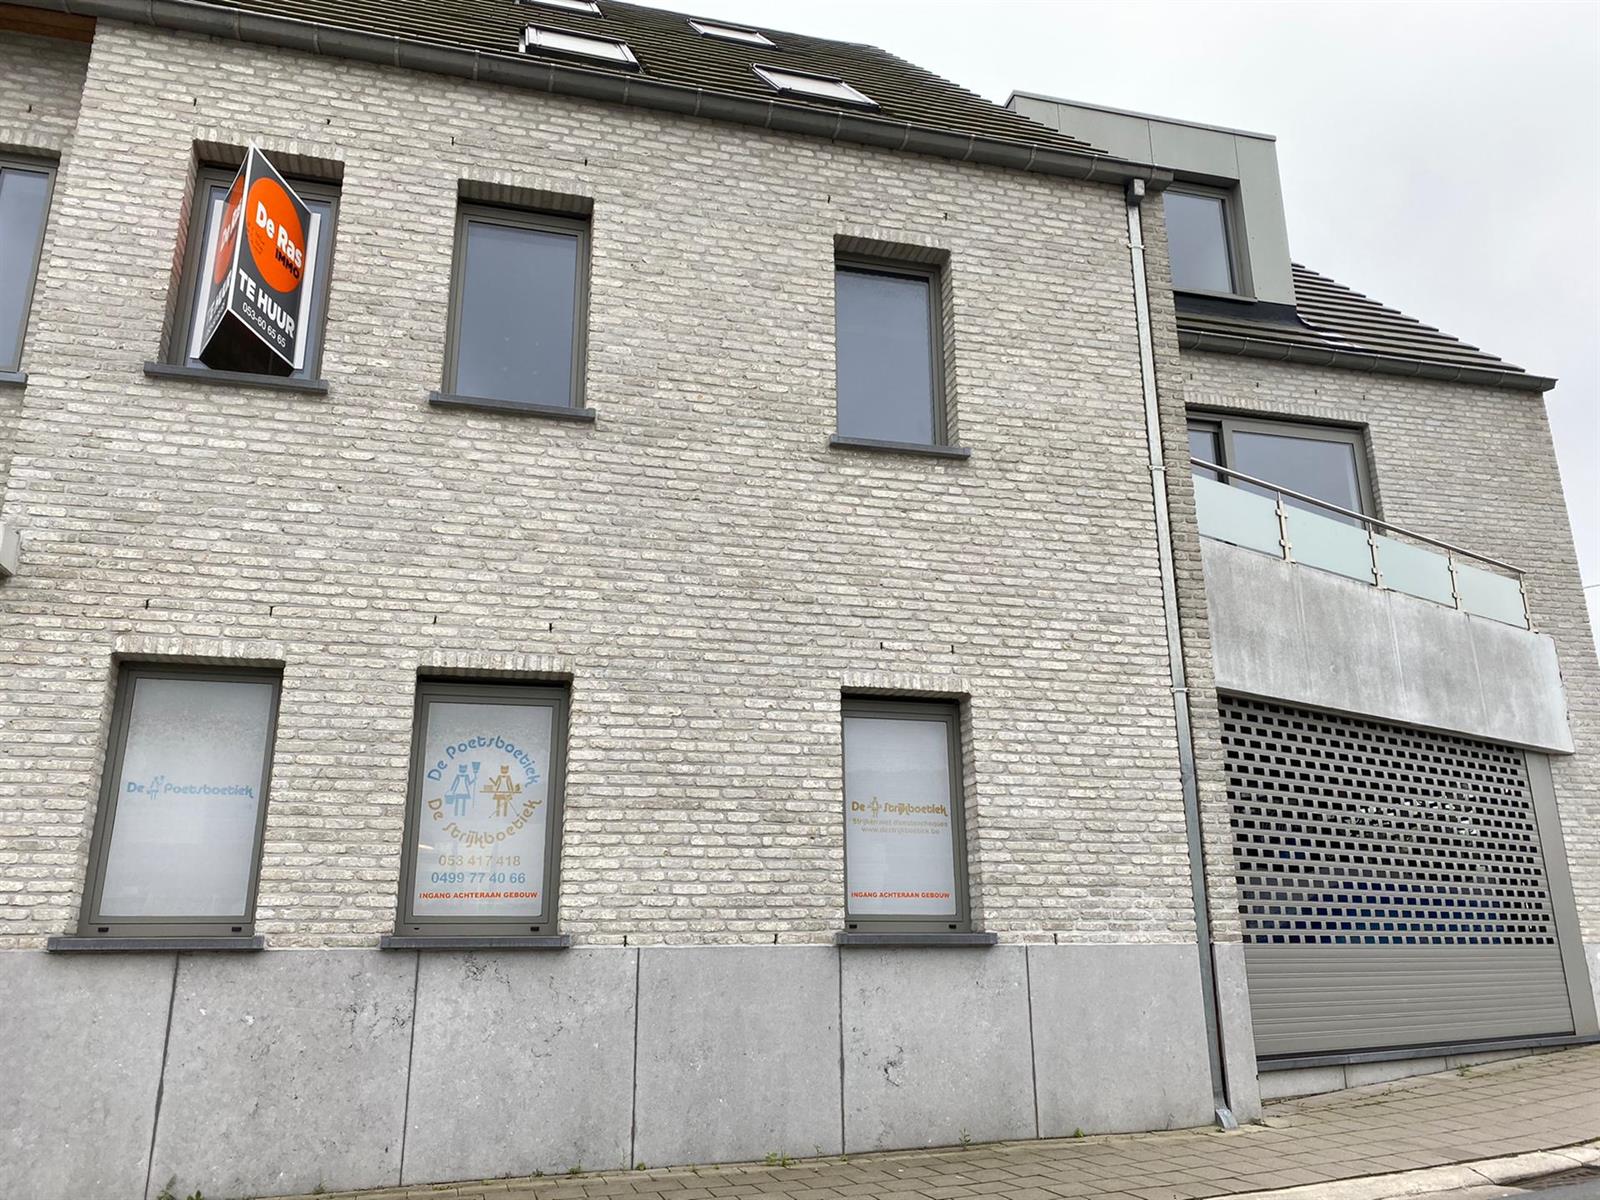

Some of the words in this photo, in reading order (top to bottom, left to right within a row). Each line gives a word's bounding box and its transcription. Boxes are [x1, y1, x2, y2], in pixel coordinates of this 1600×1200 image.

[255, 200, 275, 239] De
[277, 223, 302, 269] Ras
[275, 248, 300, 278] IMMO
[239, 268, 257, 302] TE
[257, 288, 295, 339] HUUR
[242, 302, 267, 331] 053-60
[267, 325, 277, 339] 65
[277, 334, 287, 348] 65
[427, 760, 448, 781] De
[127, 781, 144, 793] De
[163, 782, 254, 798] Poetsboetiek
[427, 797, 444, 821] De
[851, 801, 865, 812] De
[438, 854, 464, 867] 053
[467, 855, 494, 867] 417
[495, 855, 522, 867] 418
[431, 871, 465, 884] 0499
[469, 872, 486, 884] 77
[488, 872, 506, 884] 40
[509, 872, 526, 884] 66
[419, 891, 451, 900] INGANG
[453, 891, 501, 899] ACHTERAAN
[503, 891, 538, 899] GEBOUW
[851, 891, 878, 899] INGANG
